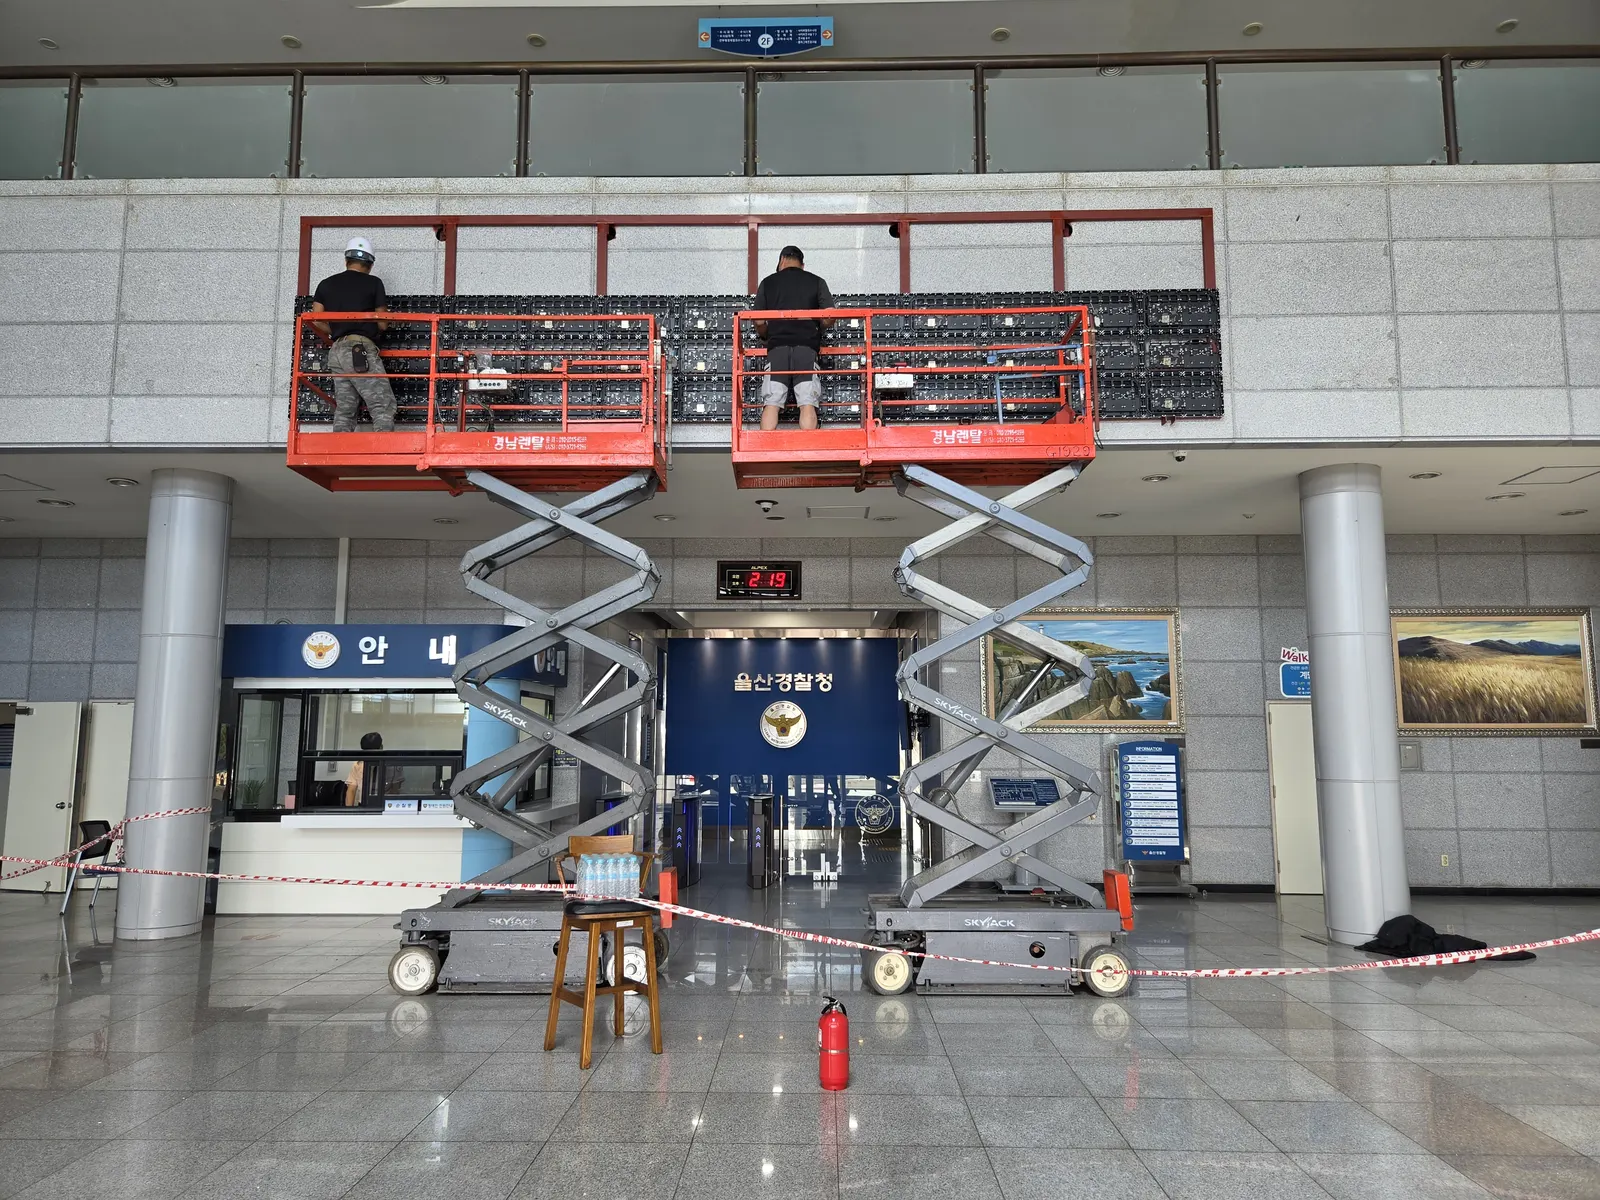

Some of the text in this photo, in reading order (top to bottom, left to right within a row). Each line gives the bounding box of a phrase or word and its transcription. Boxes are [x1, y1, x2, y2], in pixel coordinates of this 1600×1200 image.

[761, 37, 771, 46] 2F
[492, 436, 544, 450] 경남렌탈
[931, 429, 982, 444] 경남렌탈
[359, 636, 389, 665] 안
[429, 635, 457, 666] 내
[1282, 649, 1309, 662] Walk
[734, 672, 833, 692] 울산경찰청
[483, 701, 527, 728] SKYJACK
[934, 697, 979, 724] SKYJACK
[964, 916, 1015, 928] SKYJACK
